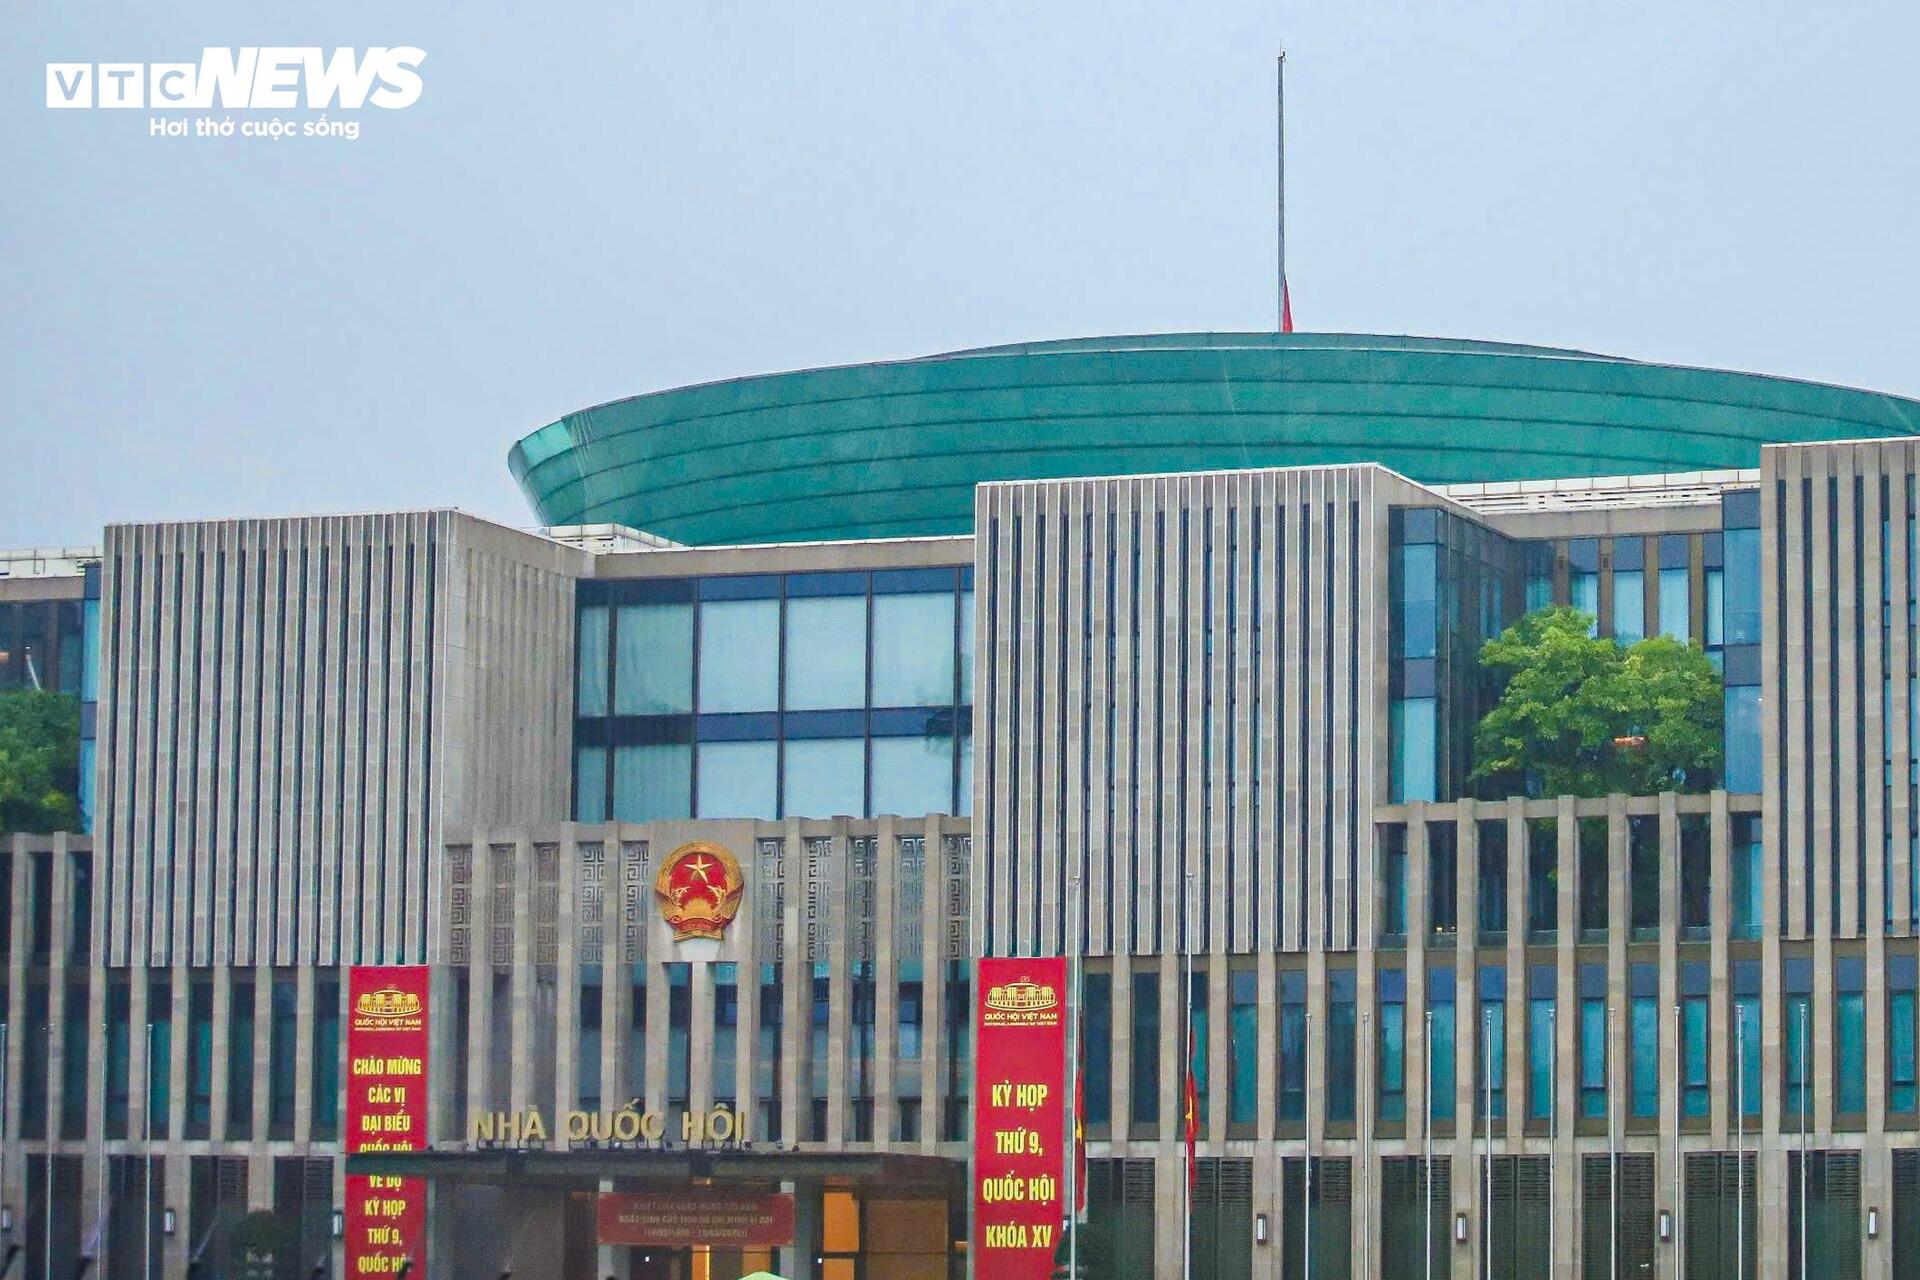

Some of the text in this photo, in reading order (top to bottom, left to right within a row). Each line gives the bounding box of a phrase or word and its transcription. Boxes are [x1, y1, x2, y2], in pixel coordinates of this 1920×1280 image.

[984, 1011, 1006, 1021] QUỐC
[1039, 1012, 1058, 1020] NAM
[353, 1055, 421, 1075] CHÀO MỪNG
[368, 1083, 406, 1107] CÁC VỊ
[992, 1079, 1048, 1112] KỲ HỌP
[362, 1108, 411, 1135] ĐẠI BIỂU
[474, 1098, 744, 1149] NHÀ QUỐC HỘI
[995, 1126, 1043, 1156] THỨ 9,
[983, 1169, 1055, 1206] QUỐC HỘI
[364, 1196, 406, 1220] KỲ HỌP
[367, 1224, 403, 1247] THỨ 9,
[986, 1220, 1053, 1248] KHÓA XV
[358, 1250, 389, 1275] QUỐC
